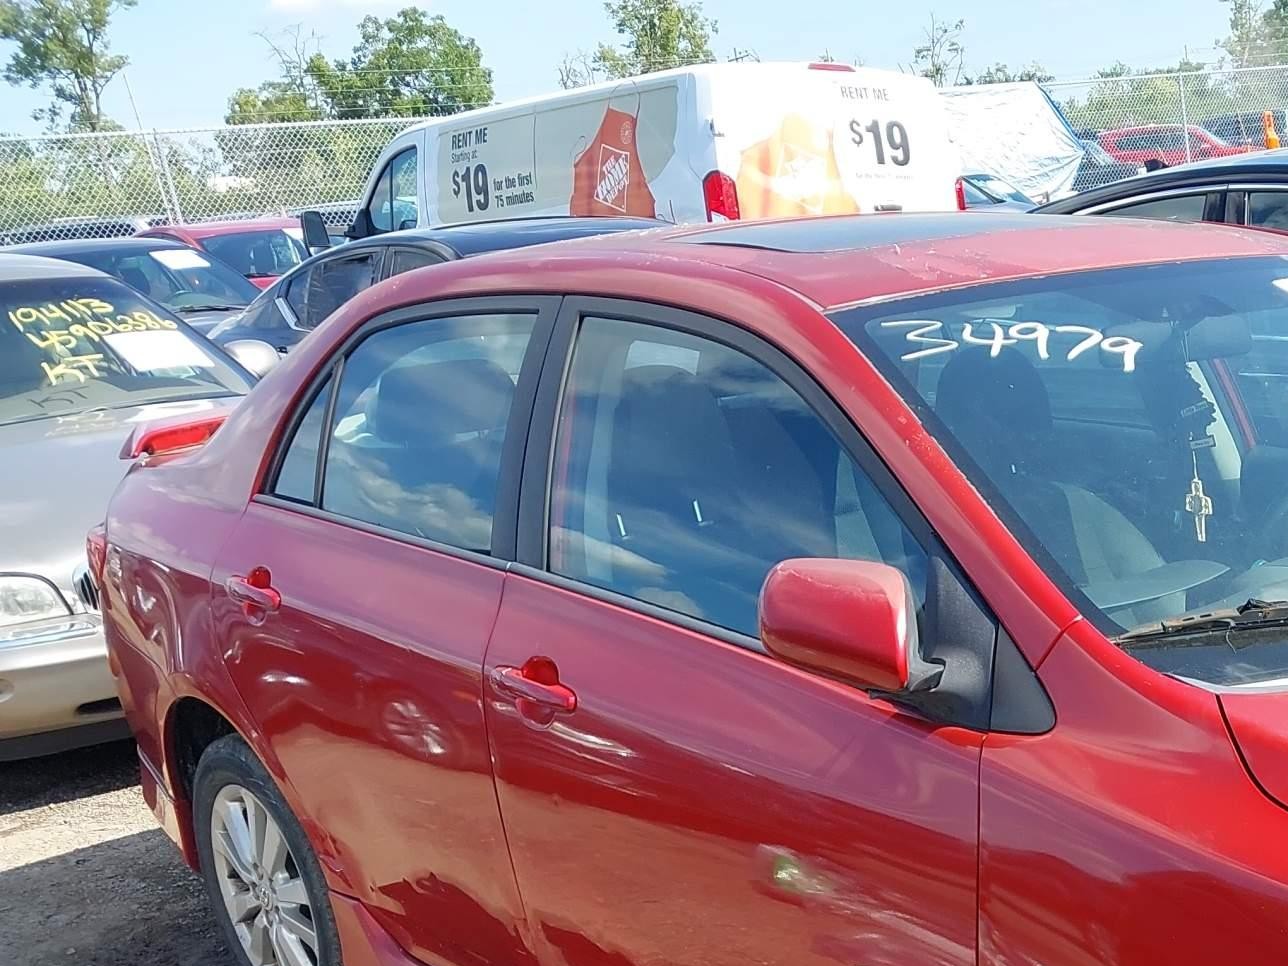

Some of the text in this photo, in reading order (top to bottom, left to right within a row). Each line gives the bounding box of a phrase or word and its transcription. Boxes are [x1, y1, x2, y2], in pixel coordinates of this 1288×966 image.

[840, 85, 889, 101] RENT ME
[451, 127, 488, 151] RENT ME
[849, 118, 910, 166] $19
[451, 151, 471, 164] Starting
[452, 163, 490, 213] $19
[493, 171, 533, 191] for the first
[495, 190, 535, 208] 75 minutes
[880, 318, 1144, 373] 34979
[40, 353, 104, 386] KT
